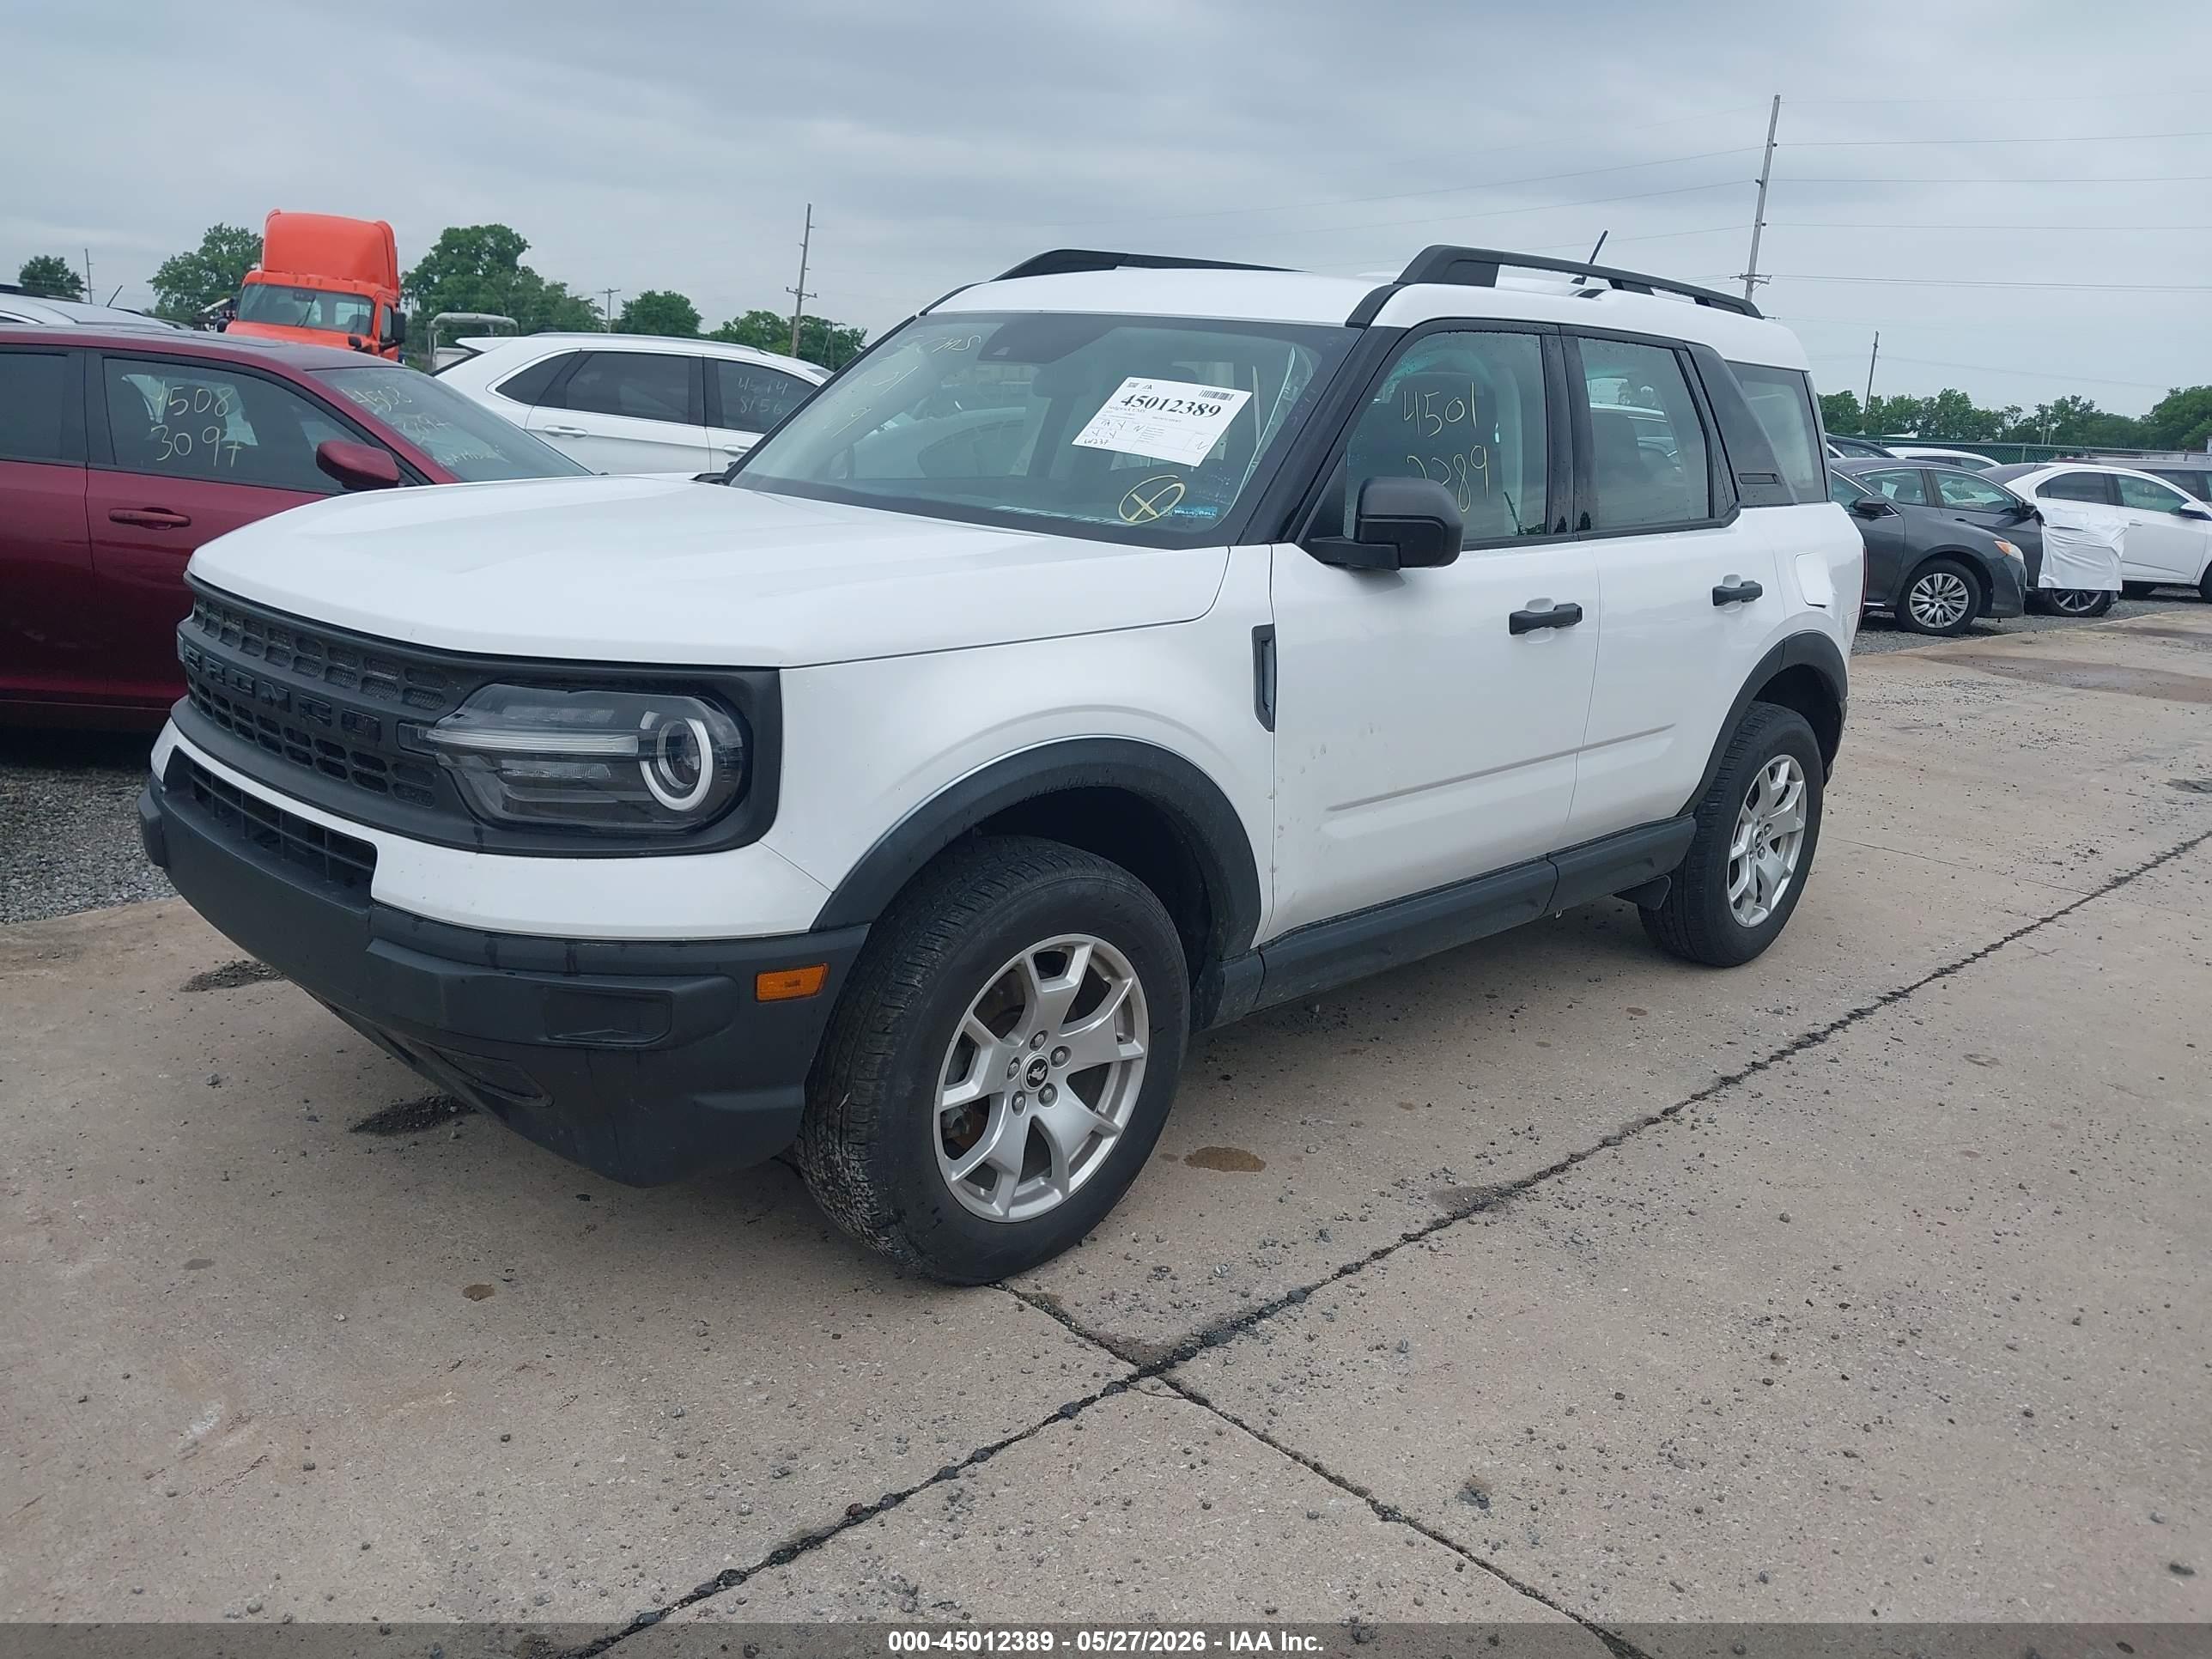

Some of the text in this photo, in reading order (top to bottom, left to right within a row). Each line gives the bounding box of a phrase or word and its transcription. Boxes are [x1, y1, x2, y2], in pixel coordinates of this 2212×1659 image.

[1121, 394, 1222, 418] 45012389
[1403, 381, 1478, 438] 4501
[151, 424, 242, 467] 3097
[185, 643, 382, 744] BRONCO
